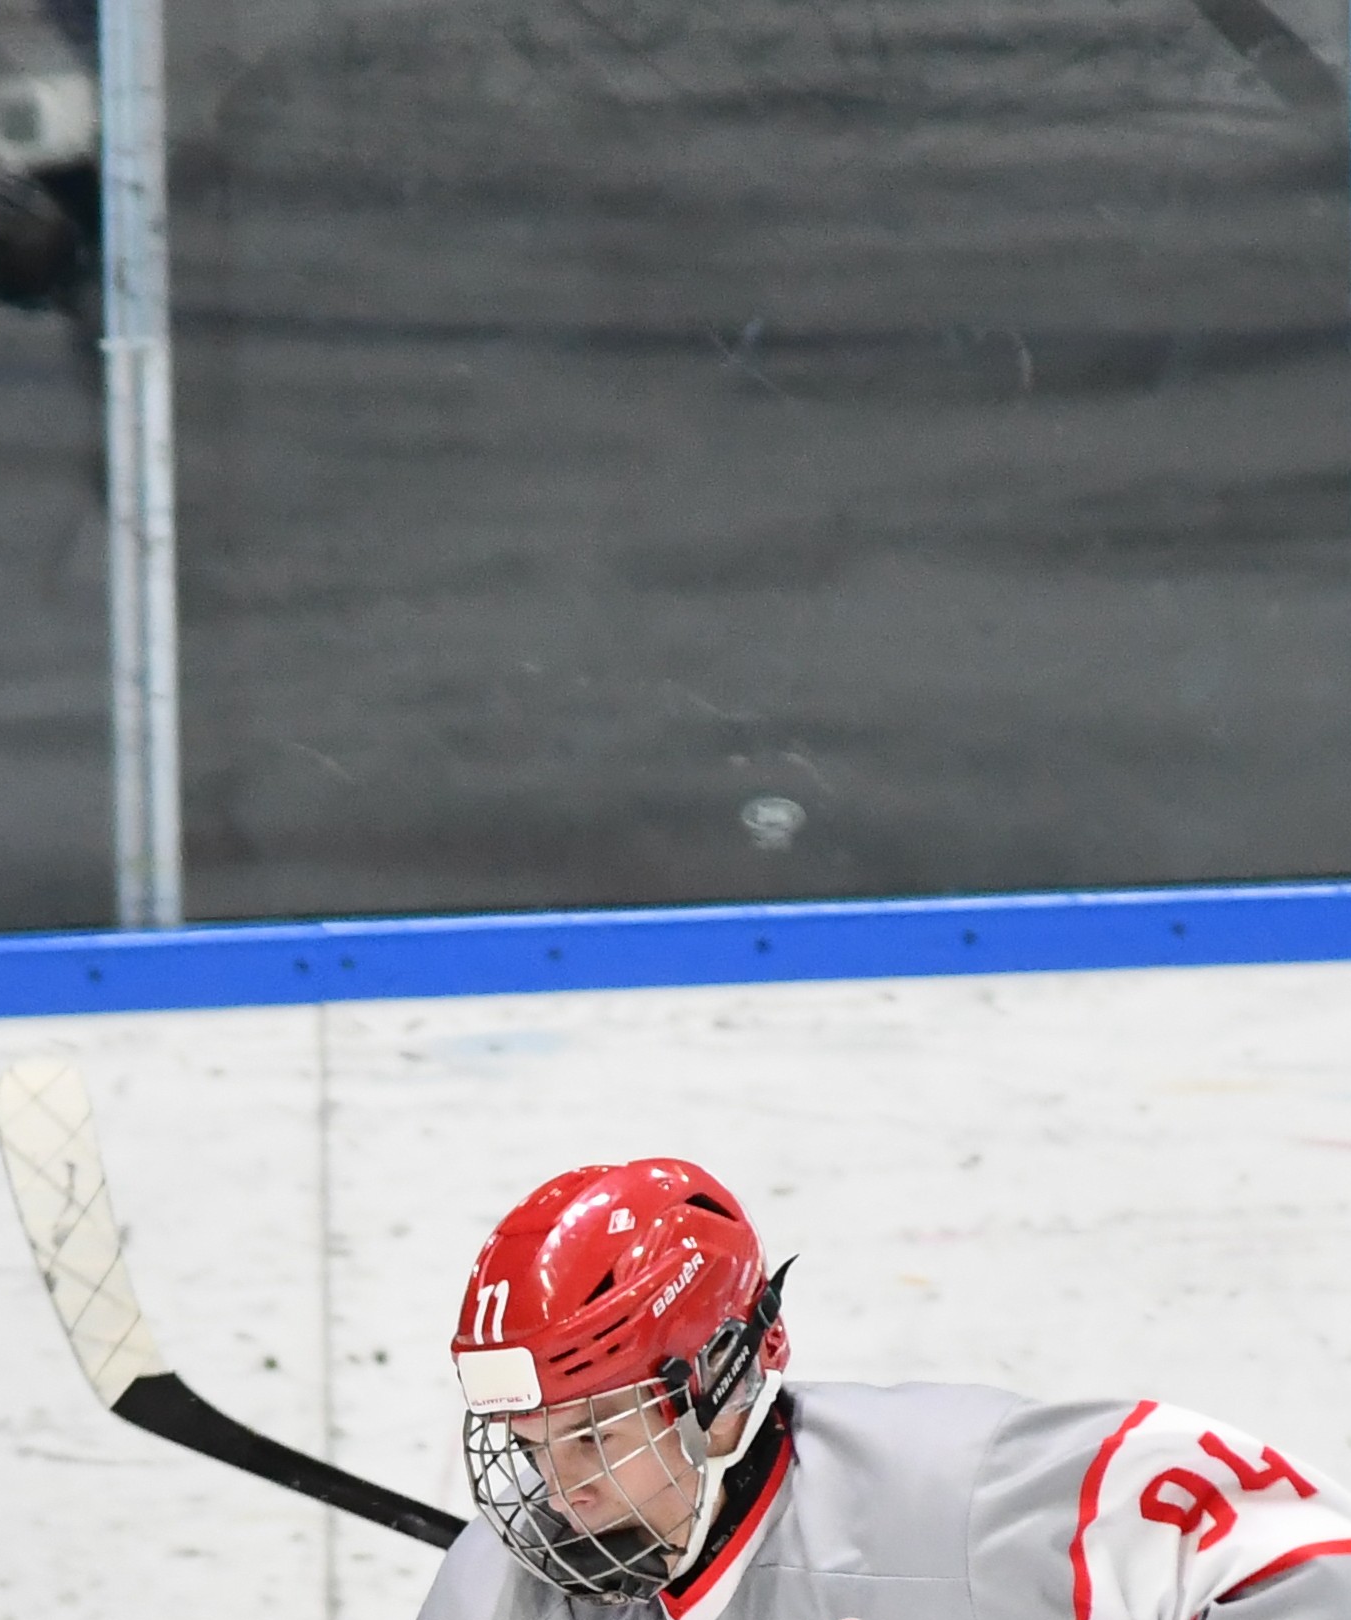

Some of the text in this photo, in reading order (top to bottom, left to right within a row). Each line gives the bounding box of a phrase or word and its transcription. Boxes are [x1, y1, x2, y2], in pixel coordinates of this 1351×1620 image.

[473, 1279, 510, 1345] 11
[652, 1252, 705, 1318] BAUER
[1139, 1430, 1320, 1552] 94
